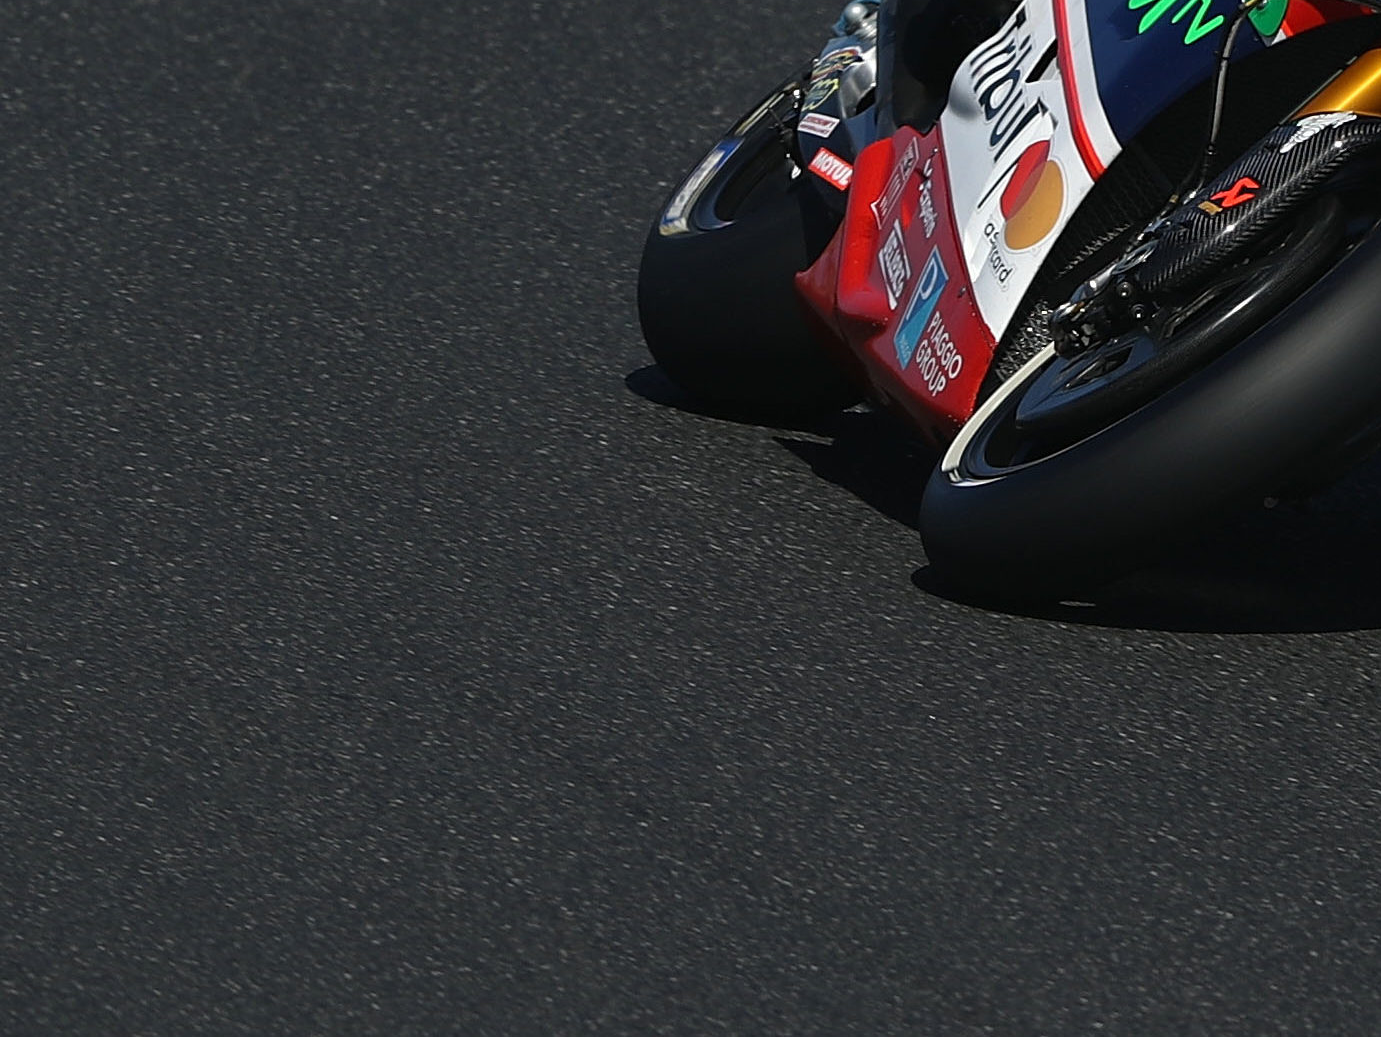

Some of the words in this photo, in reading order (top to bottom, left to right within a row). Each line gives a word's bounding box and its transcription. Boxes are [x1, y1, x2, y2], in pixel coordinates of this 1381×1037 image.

[816, 150, 853, 185] MOTUL
[915, 341, 946, 397] GROUP
[928, 311, 963, 380] PIAGGIO
